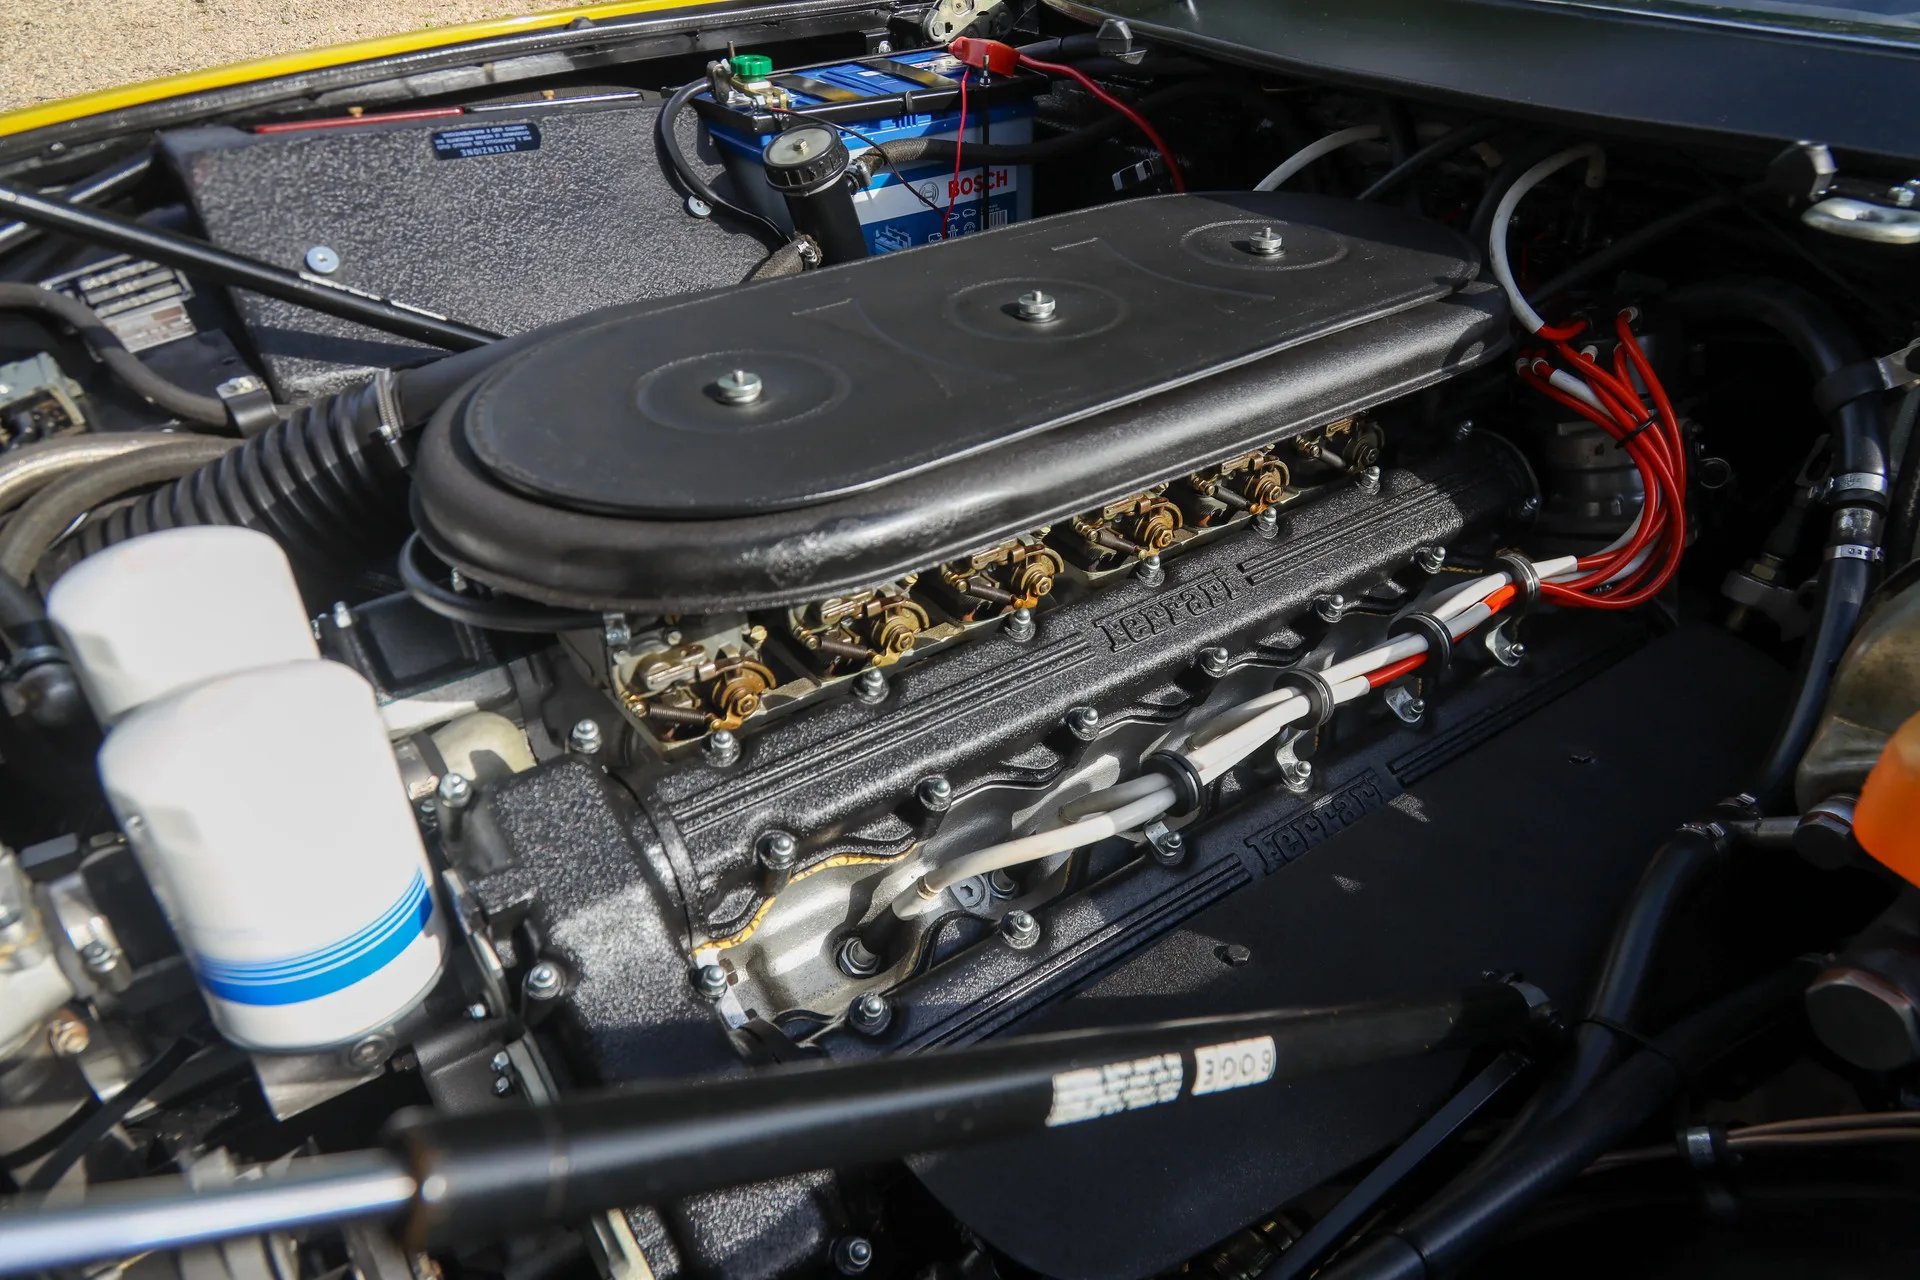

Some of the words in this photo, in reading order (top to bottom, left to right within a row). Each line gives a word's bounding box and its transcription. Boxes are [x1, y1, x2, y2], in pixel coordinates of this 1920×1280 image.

[460, 144, 516, 157] ATTENZIONE
[948, 169, 1008, 198] BOSCH
[1093, 567, 1242, 652] Ferrari
[1243, 767, 1384, 875] Ferrari
